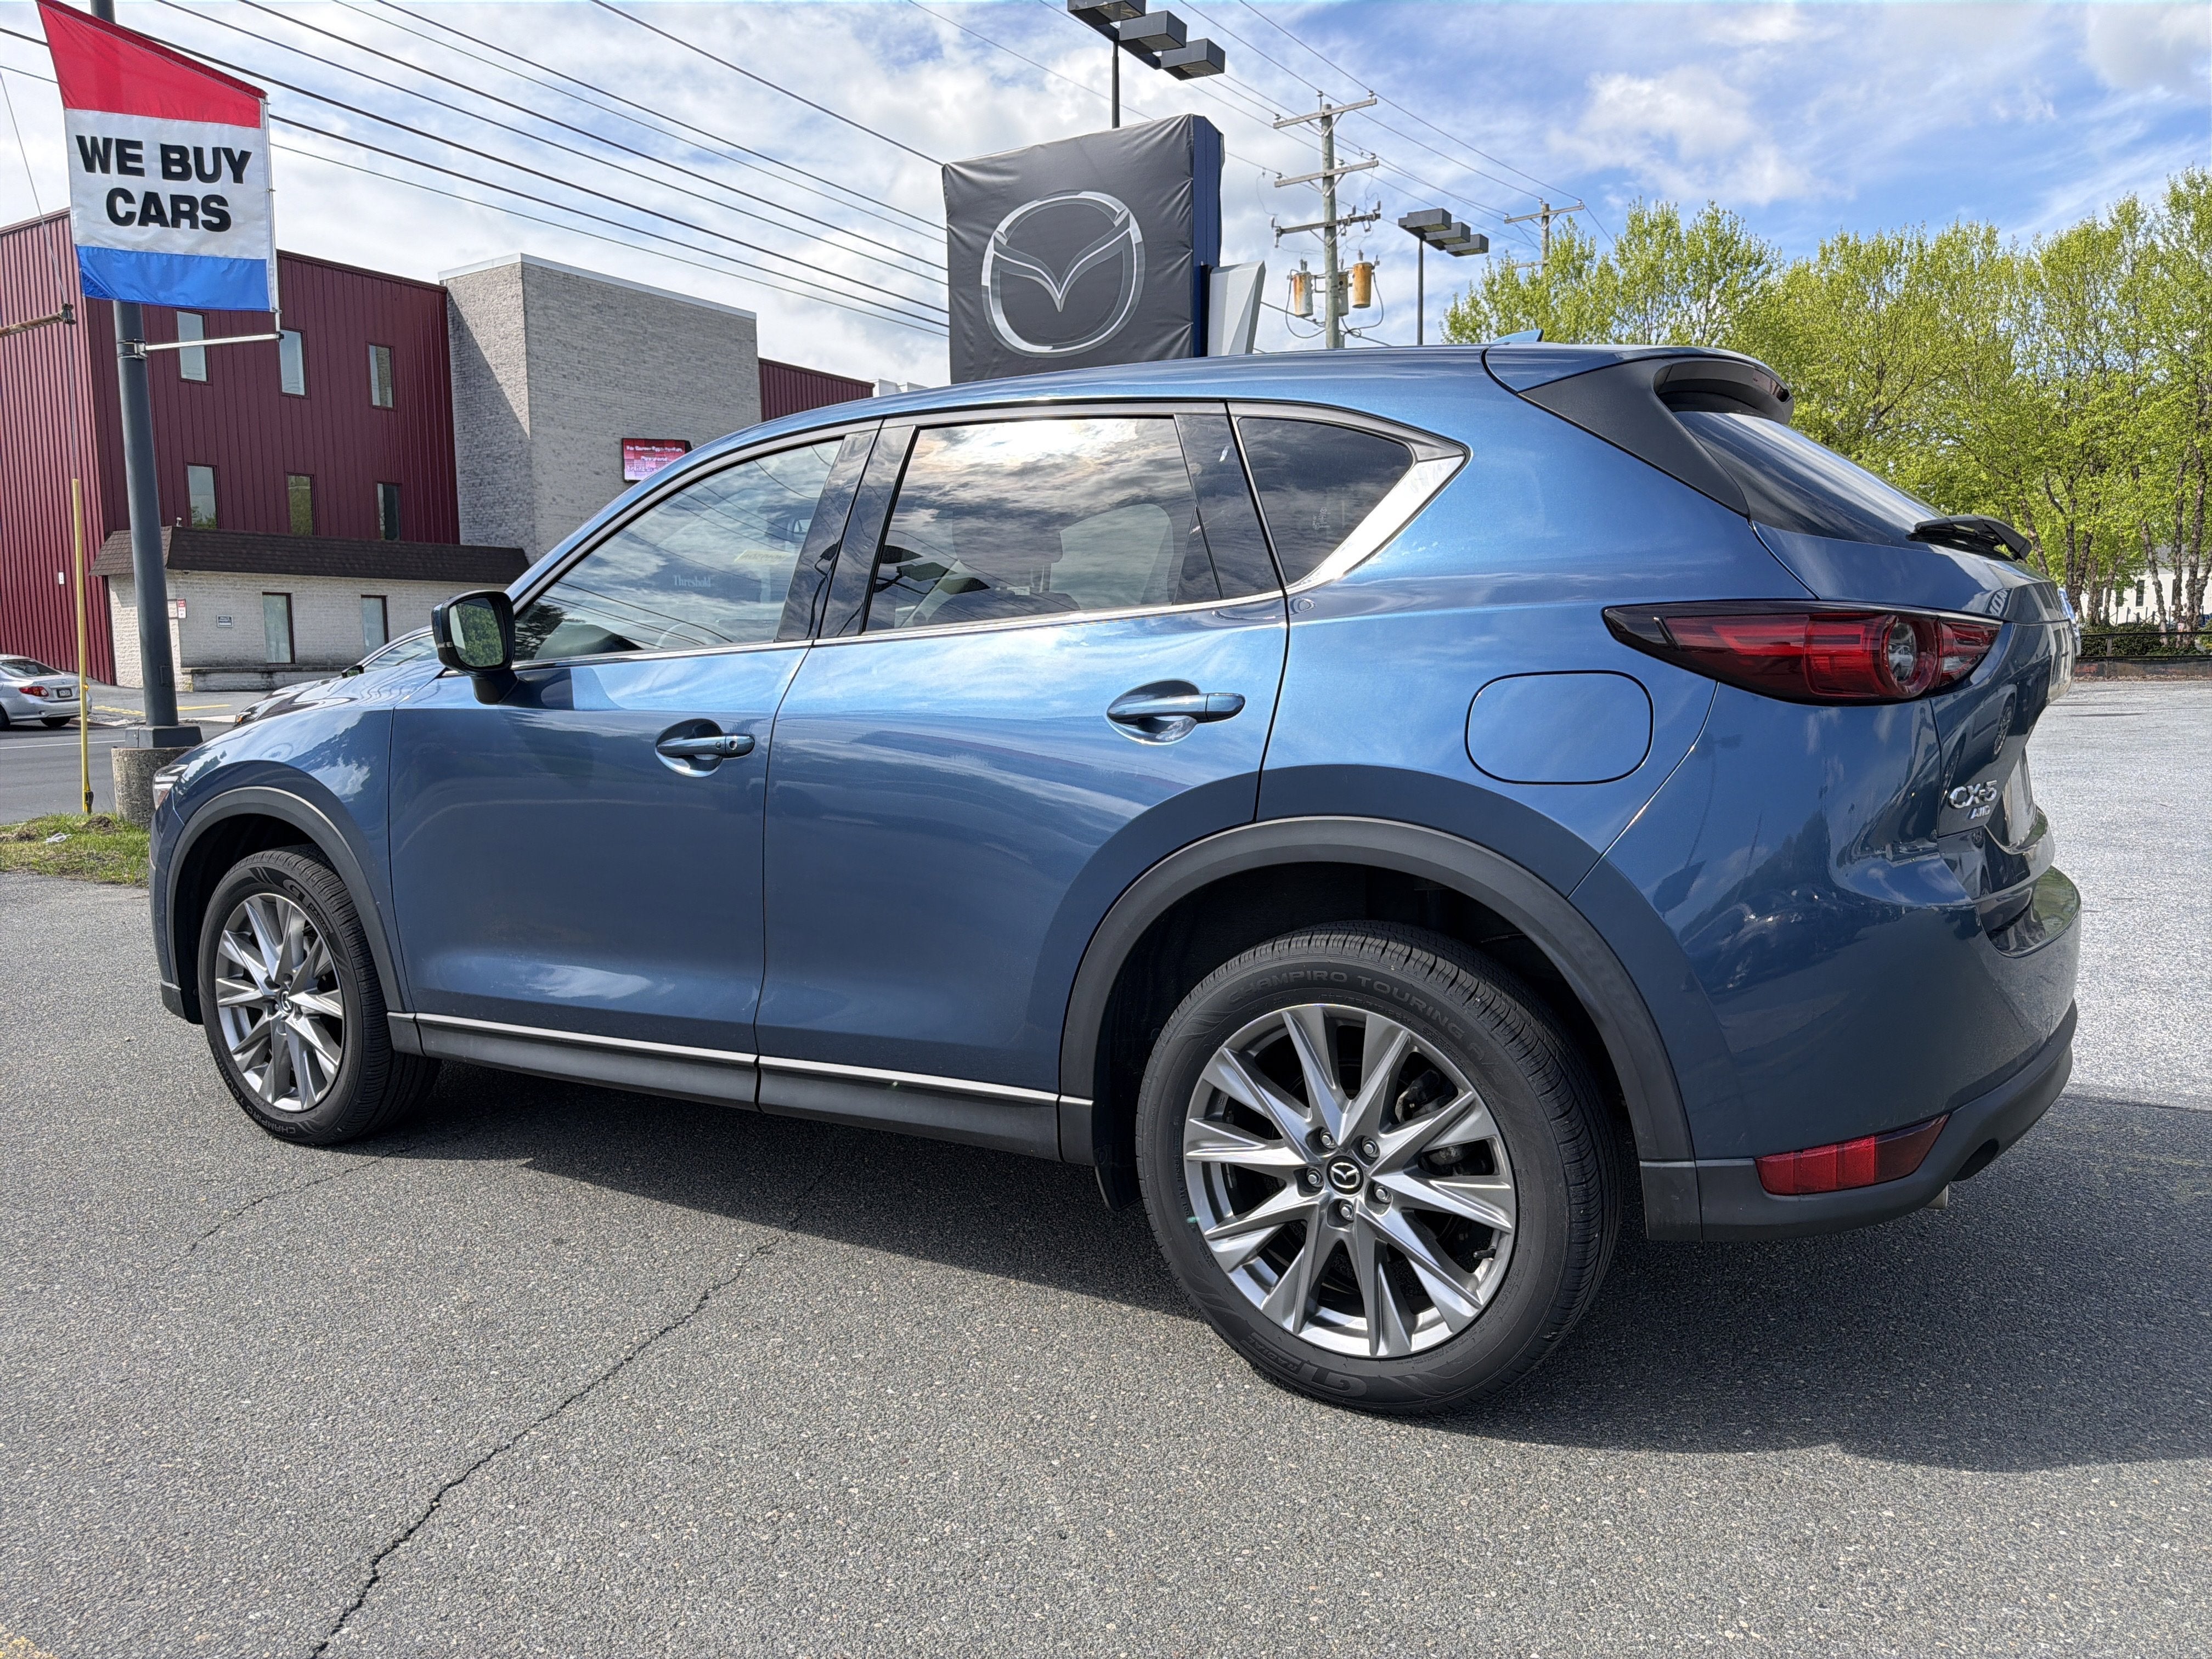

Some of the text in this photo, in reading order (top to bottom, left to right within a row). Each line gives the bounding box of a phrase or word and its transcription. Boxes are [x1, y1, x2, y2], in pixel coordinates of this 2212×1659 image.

[76, 135, 252, 184] WE BUY
[106, 188, 232, 232] CARS
[673, 575, 712, 587] Threshold
[1949, 780, 1997, 809] CX-5
[1229, 970, 1347, 1003] CHAMPIRO
[1357, 975, 1465, 1040] TOURING
[213, 1050, 244, 1105] TOURING
[247, 1105, 296, 1134] CHAMPIRO
